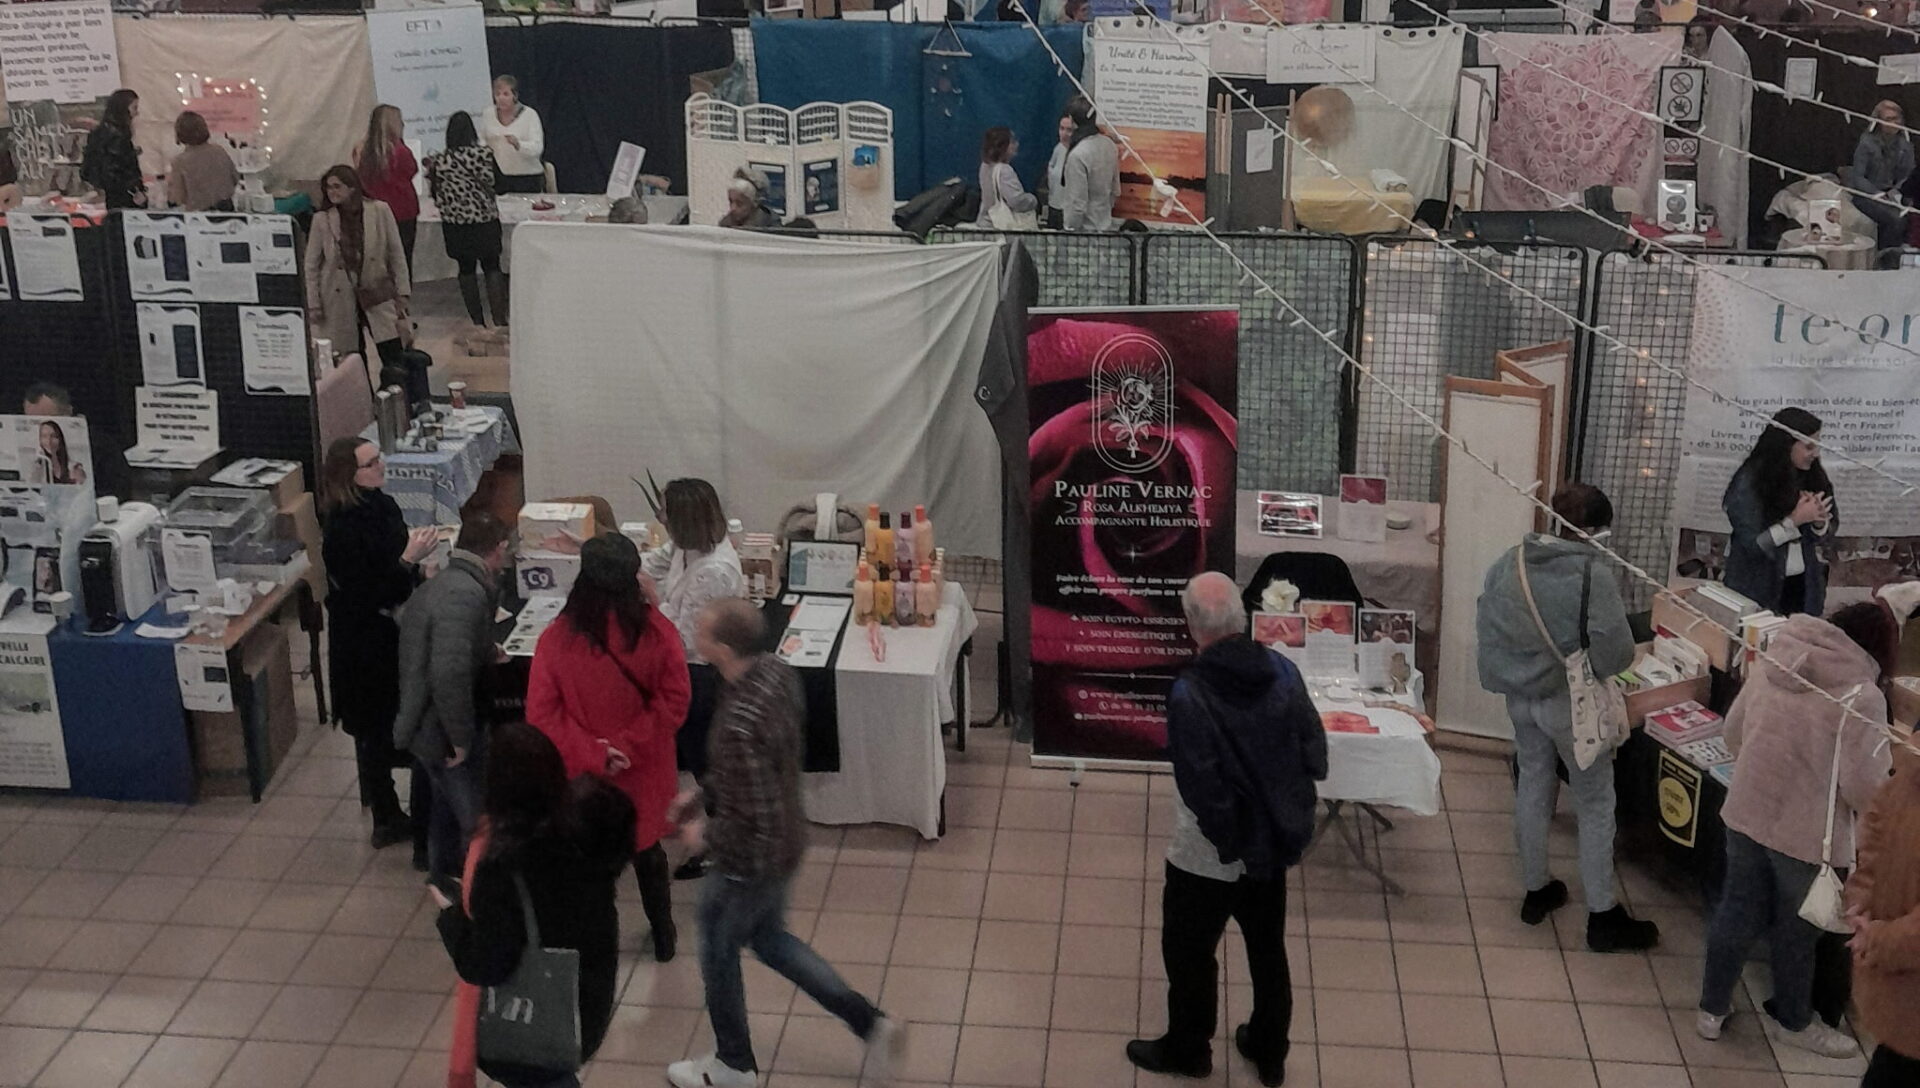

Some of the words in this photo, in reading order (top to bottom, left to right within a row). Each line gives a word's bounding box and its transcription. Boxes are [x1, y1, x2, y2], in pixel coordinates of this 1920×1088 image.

[1752, 396, 1784, 408] grand
[1786, 397, 1830, 408] magasin
[1860, 420, 1895, 431] France
[1054, 480, 1132, 499] PAULINE
[1137, 481, 1213, 500] VERNAC
[1082, 500, 1115, 514] ROSA
[1118, 500, 1183, 514] ALKHEMYA
[1054, 514, 1148, 527] ACCOMPAGNANTE
[1150, 515, 1212, 528] HOLISTIQUE
[527, 570, 549, 588] C9
[1096, 644, 1141, 655] TRIANGLE
